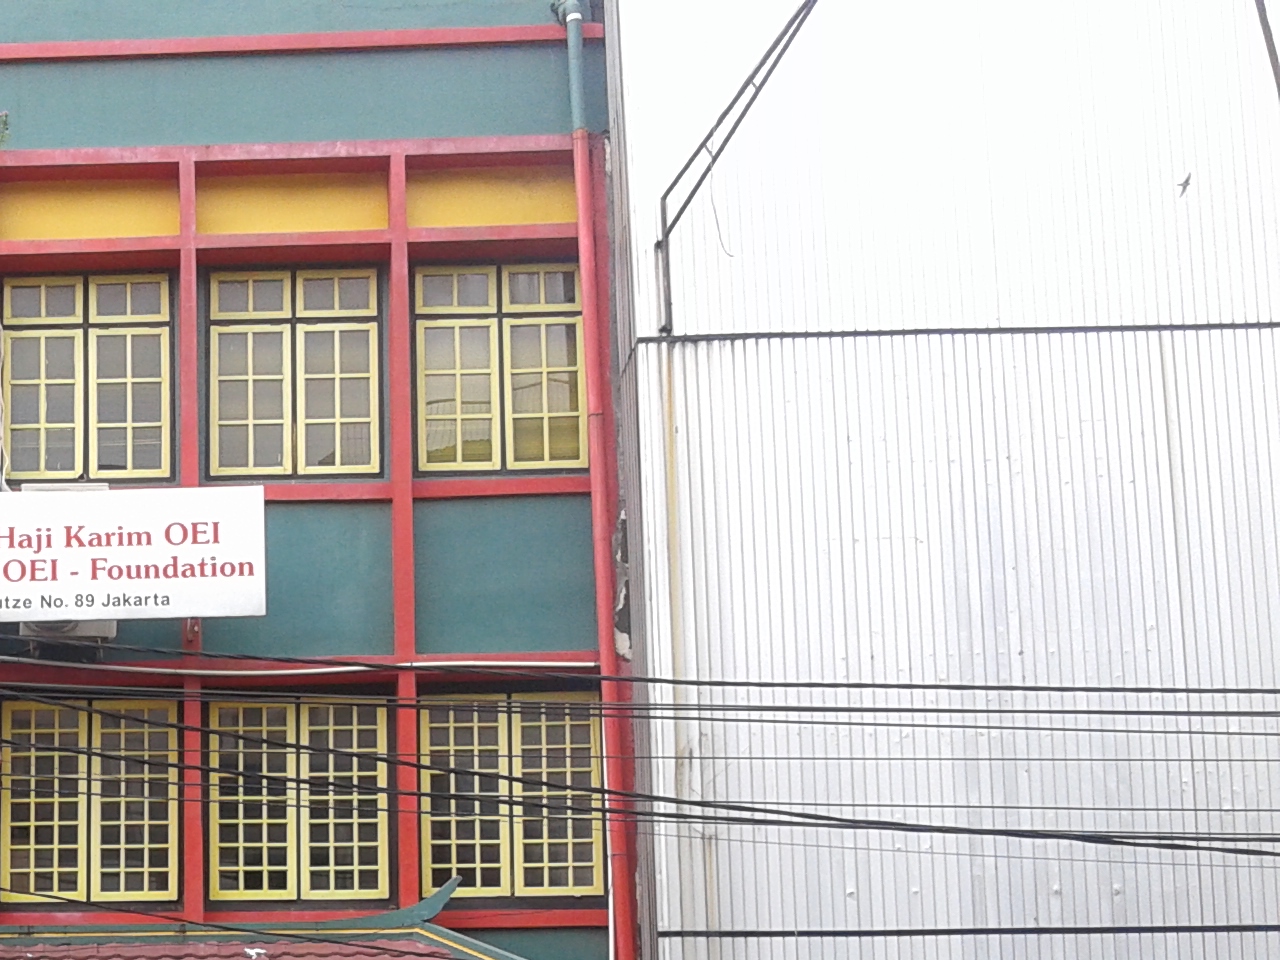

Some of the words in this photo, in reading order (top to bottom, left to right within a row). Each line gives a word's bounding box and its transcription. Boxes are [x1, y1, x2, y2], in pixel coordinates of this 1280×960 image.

[64, 525, 152, 548] Karim
[165, 521, 220, 545] OEI
[3, 558, 58, 582] OEI
[90, 554, 255, 581] Foundation
[40, 595, 69, 608] No.
[74, 594, 95, 608] 89
[101, 592, 171, 608] Jakarta
